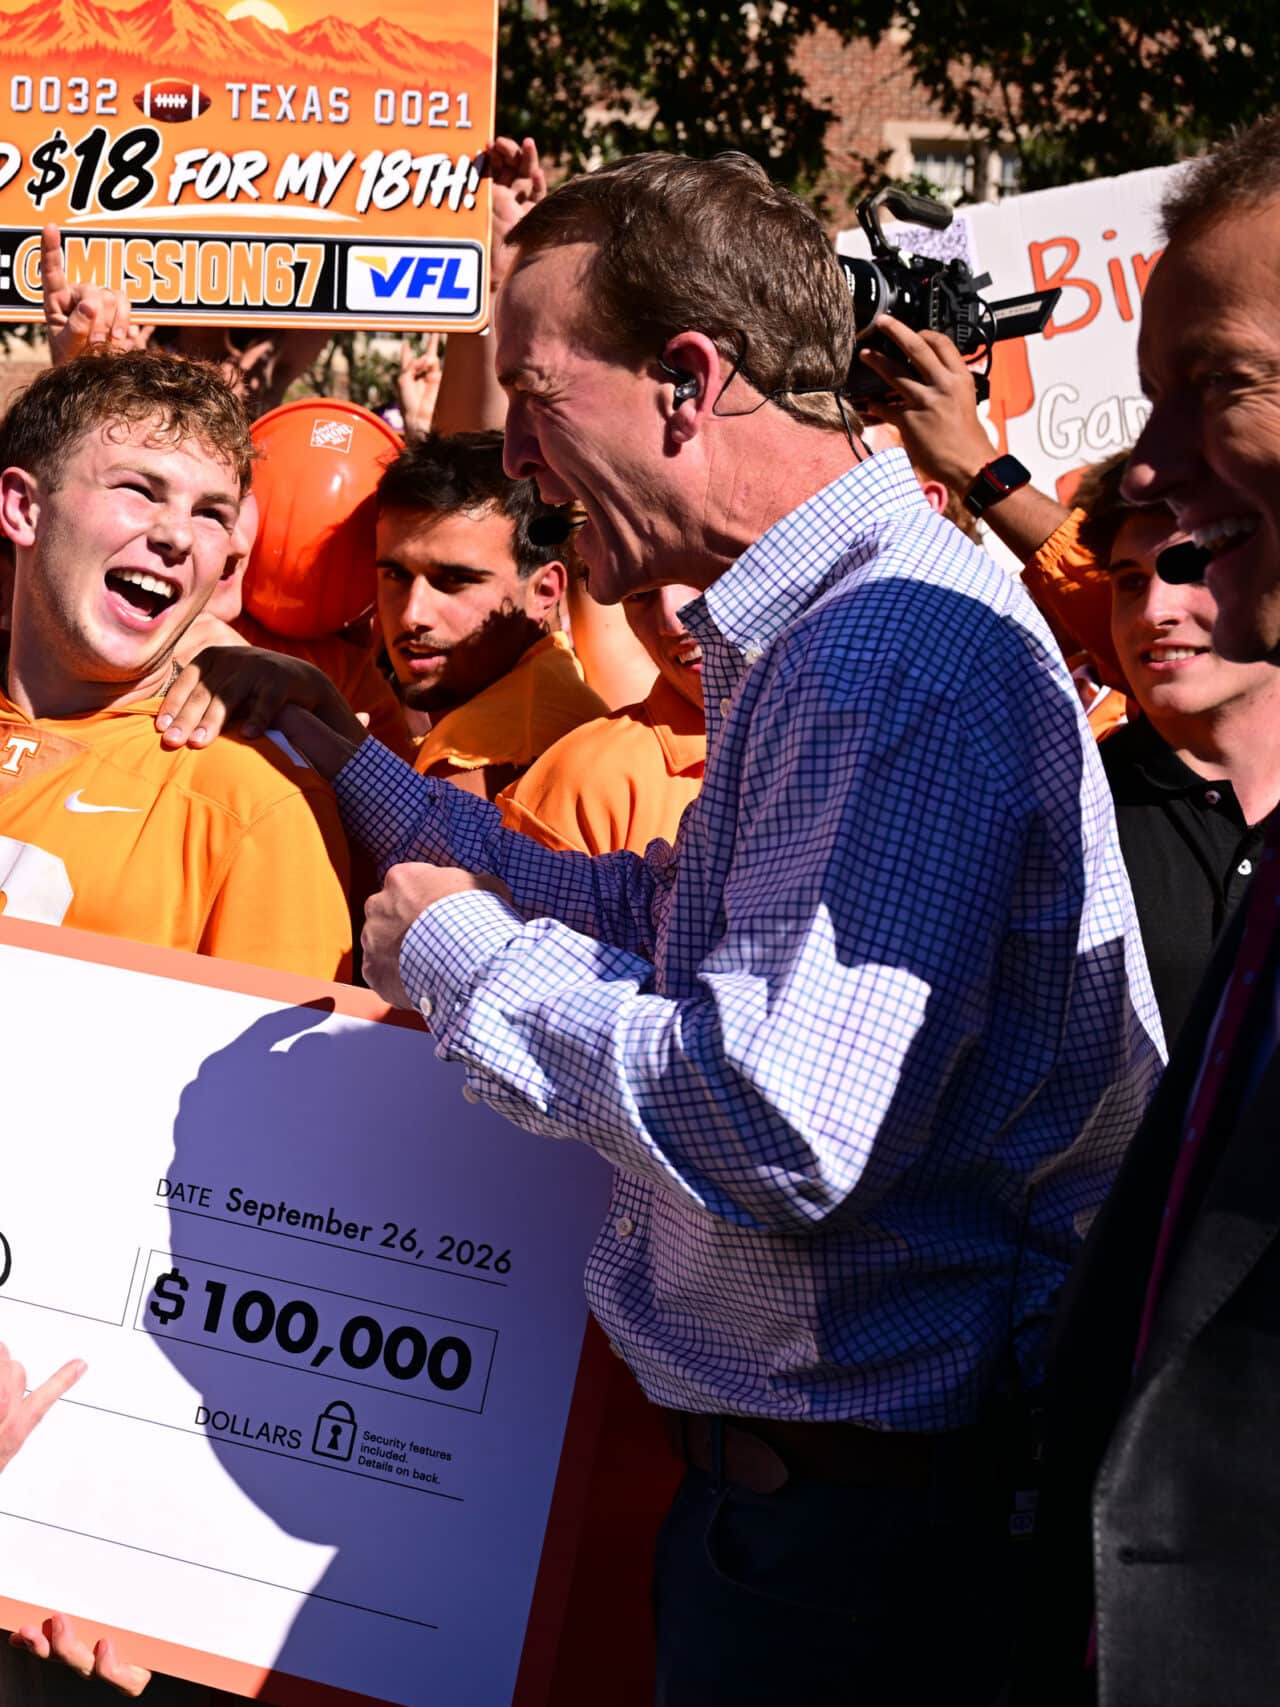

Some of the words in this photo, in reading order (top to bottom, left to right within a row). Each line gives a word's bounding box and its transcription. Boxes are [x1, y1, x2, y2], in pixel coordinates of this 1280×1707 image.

[10, 74, 118, 115] 0032
[225, 82, 350, 124] TEXAS
[374, 88, 473, 129] 0021
[25, 126, 164, 215] $18
[167, 147, 269, 206] FOR
[273, 149, 356, 209] MY
[355, 149, 480, 215] 18TH!
[354, 254, 472, 300] VFL
[156, 1178, 213, 1208] DATE
[225, 1187, 372, 1242] September
[379, 1222, 426, 1260] 26,
[435, 1235, 513, 1275] 2026
[195, 1405, 302, 1450] DOLLARS
[363, 1430, 407, 1452] Security
[409, 1441, 453, 1462] features
[358, 1455, 393, 1473] Details
[395, 1466, 410, 1477] on
[412, 1468, 441, 1485] back.
[360, 1444, 409, 1464] included.
